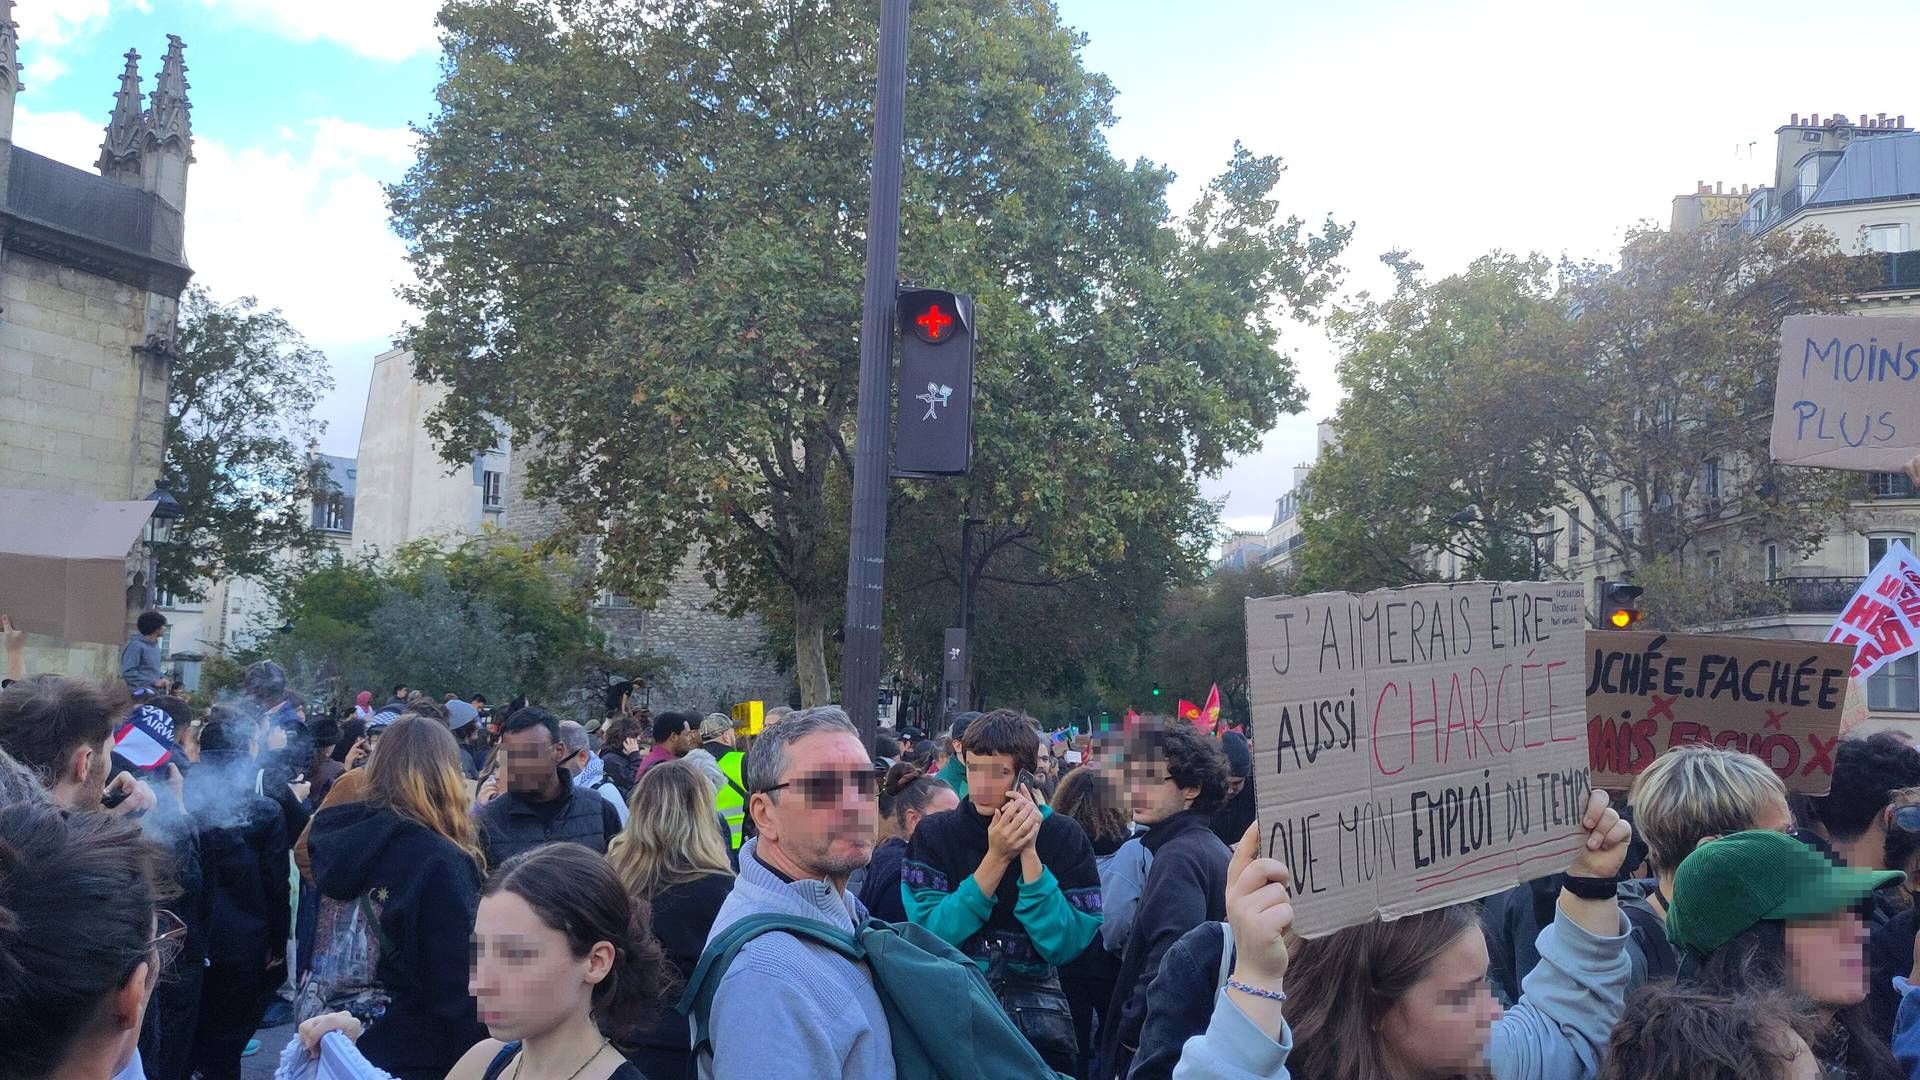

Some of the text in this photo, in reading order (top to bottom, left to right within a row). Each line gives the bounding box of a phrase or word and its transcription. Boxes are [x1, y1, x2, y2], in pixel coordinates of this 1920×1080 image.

[1802, 337, 1920, 382] MOINS
[1792, 400, 1896, 447] PLUS
[1272, 585, 1553, 675] J'AIMERAIS ÊTRE
[142, 715, 175, 742] AIRW
[1277, 648, 1577, 777] AUSSI CHARGÉE
[1268, 767, 1592, 898] QUE MON EMPLOI DU TEMPS
